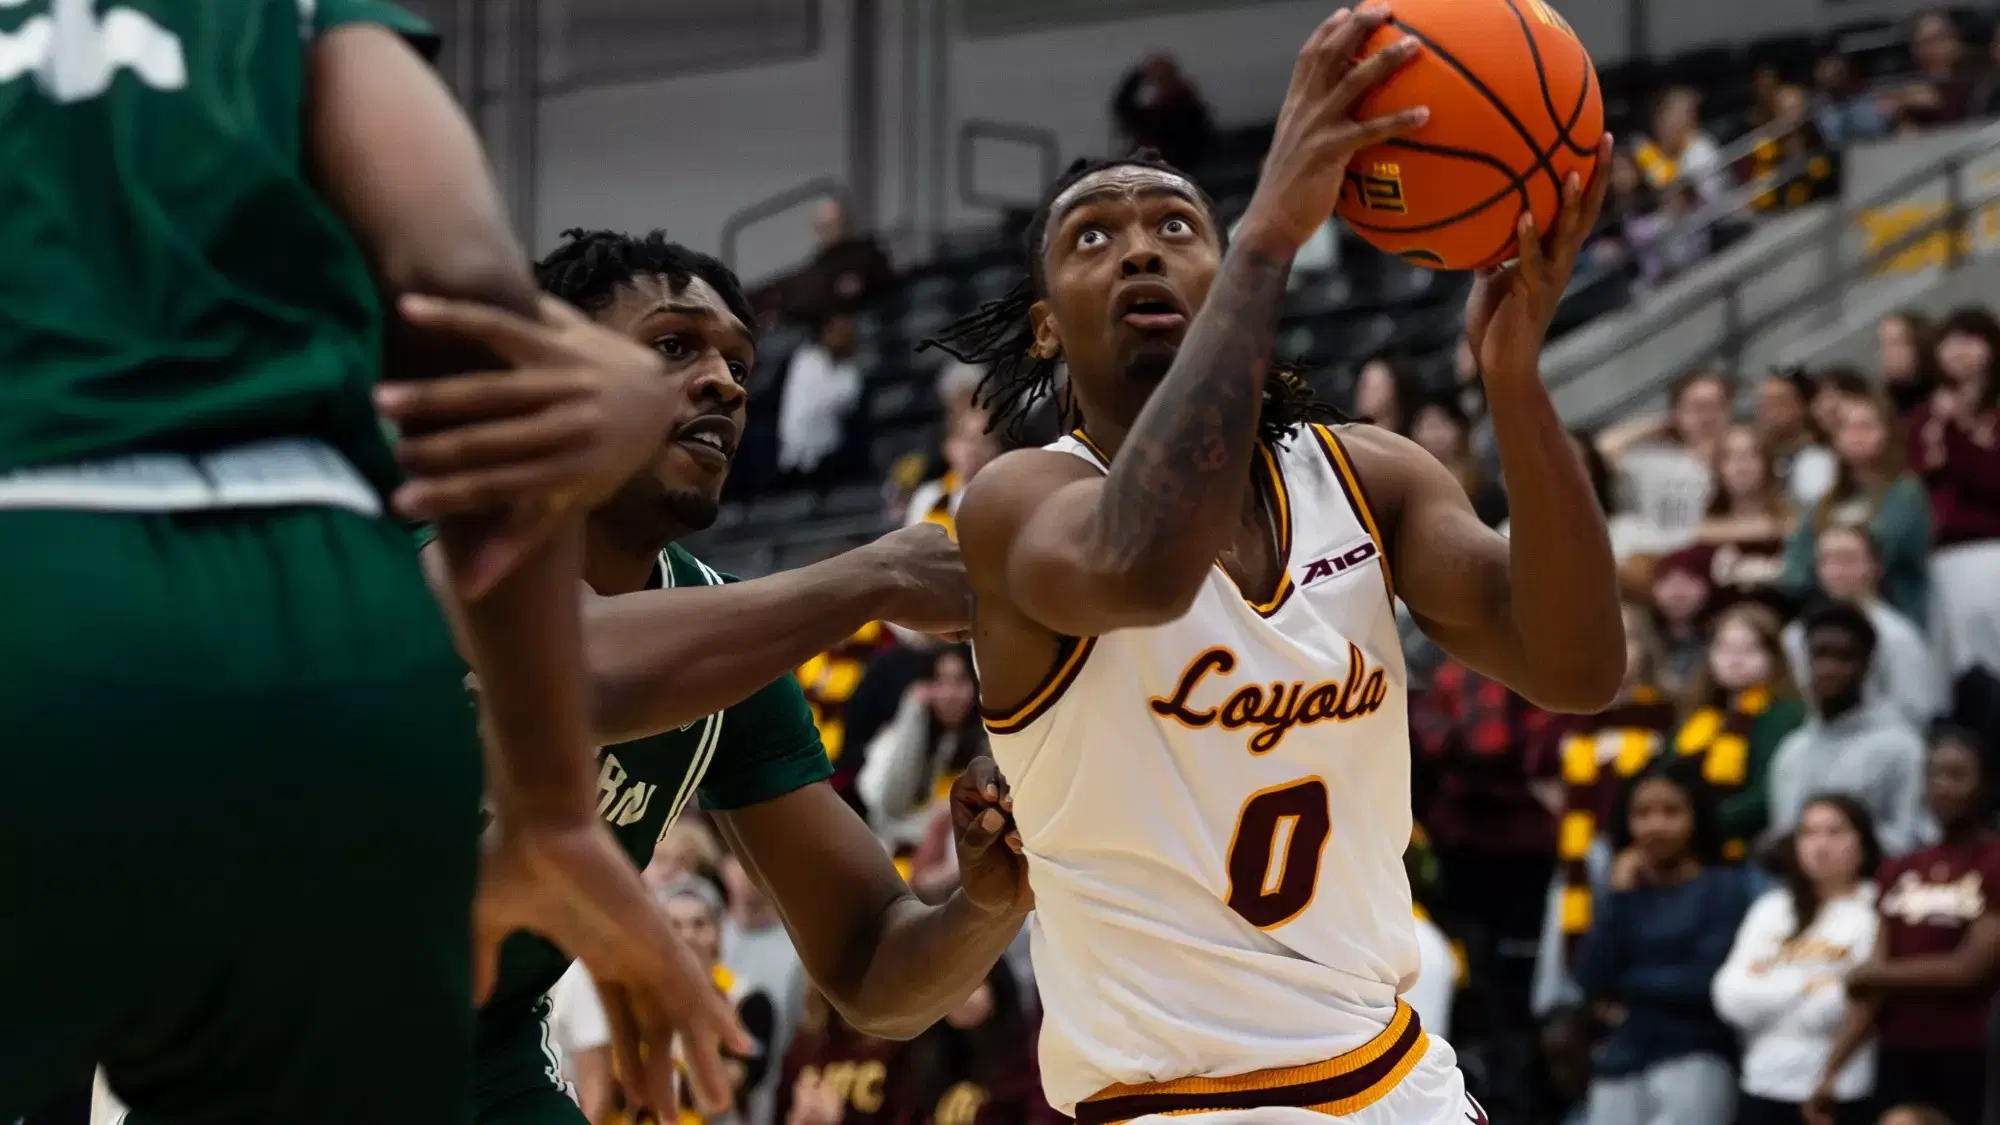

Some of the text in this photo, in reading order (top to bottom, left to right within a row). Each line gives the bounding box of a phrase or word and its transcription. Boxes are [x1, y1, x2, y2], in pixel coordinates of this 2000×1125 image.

[1301, 542, 1376, 585] A10
[1149, 642, 1388, 756] Loyola
[594, 746, 657, 827] RN
[1226, 775, 1332, 931] 0
